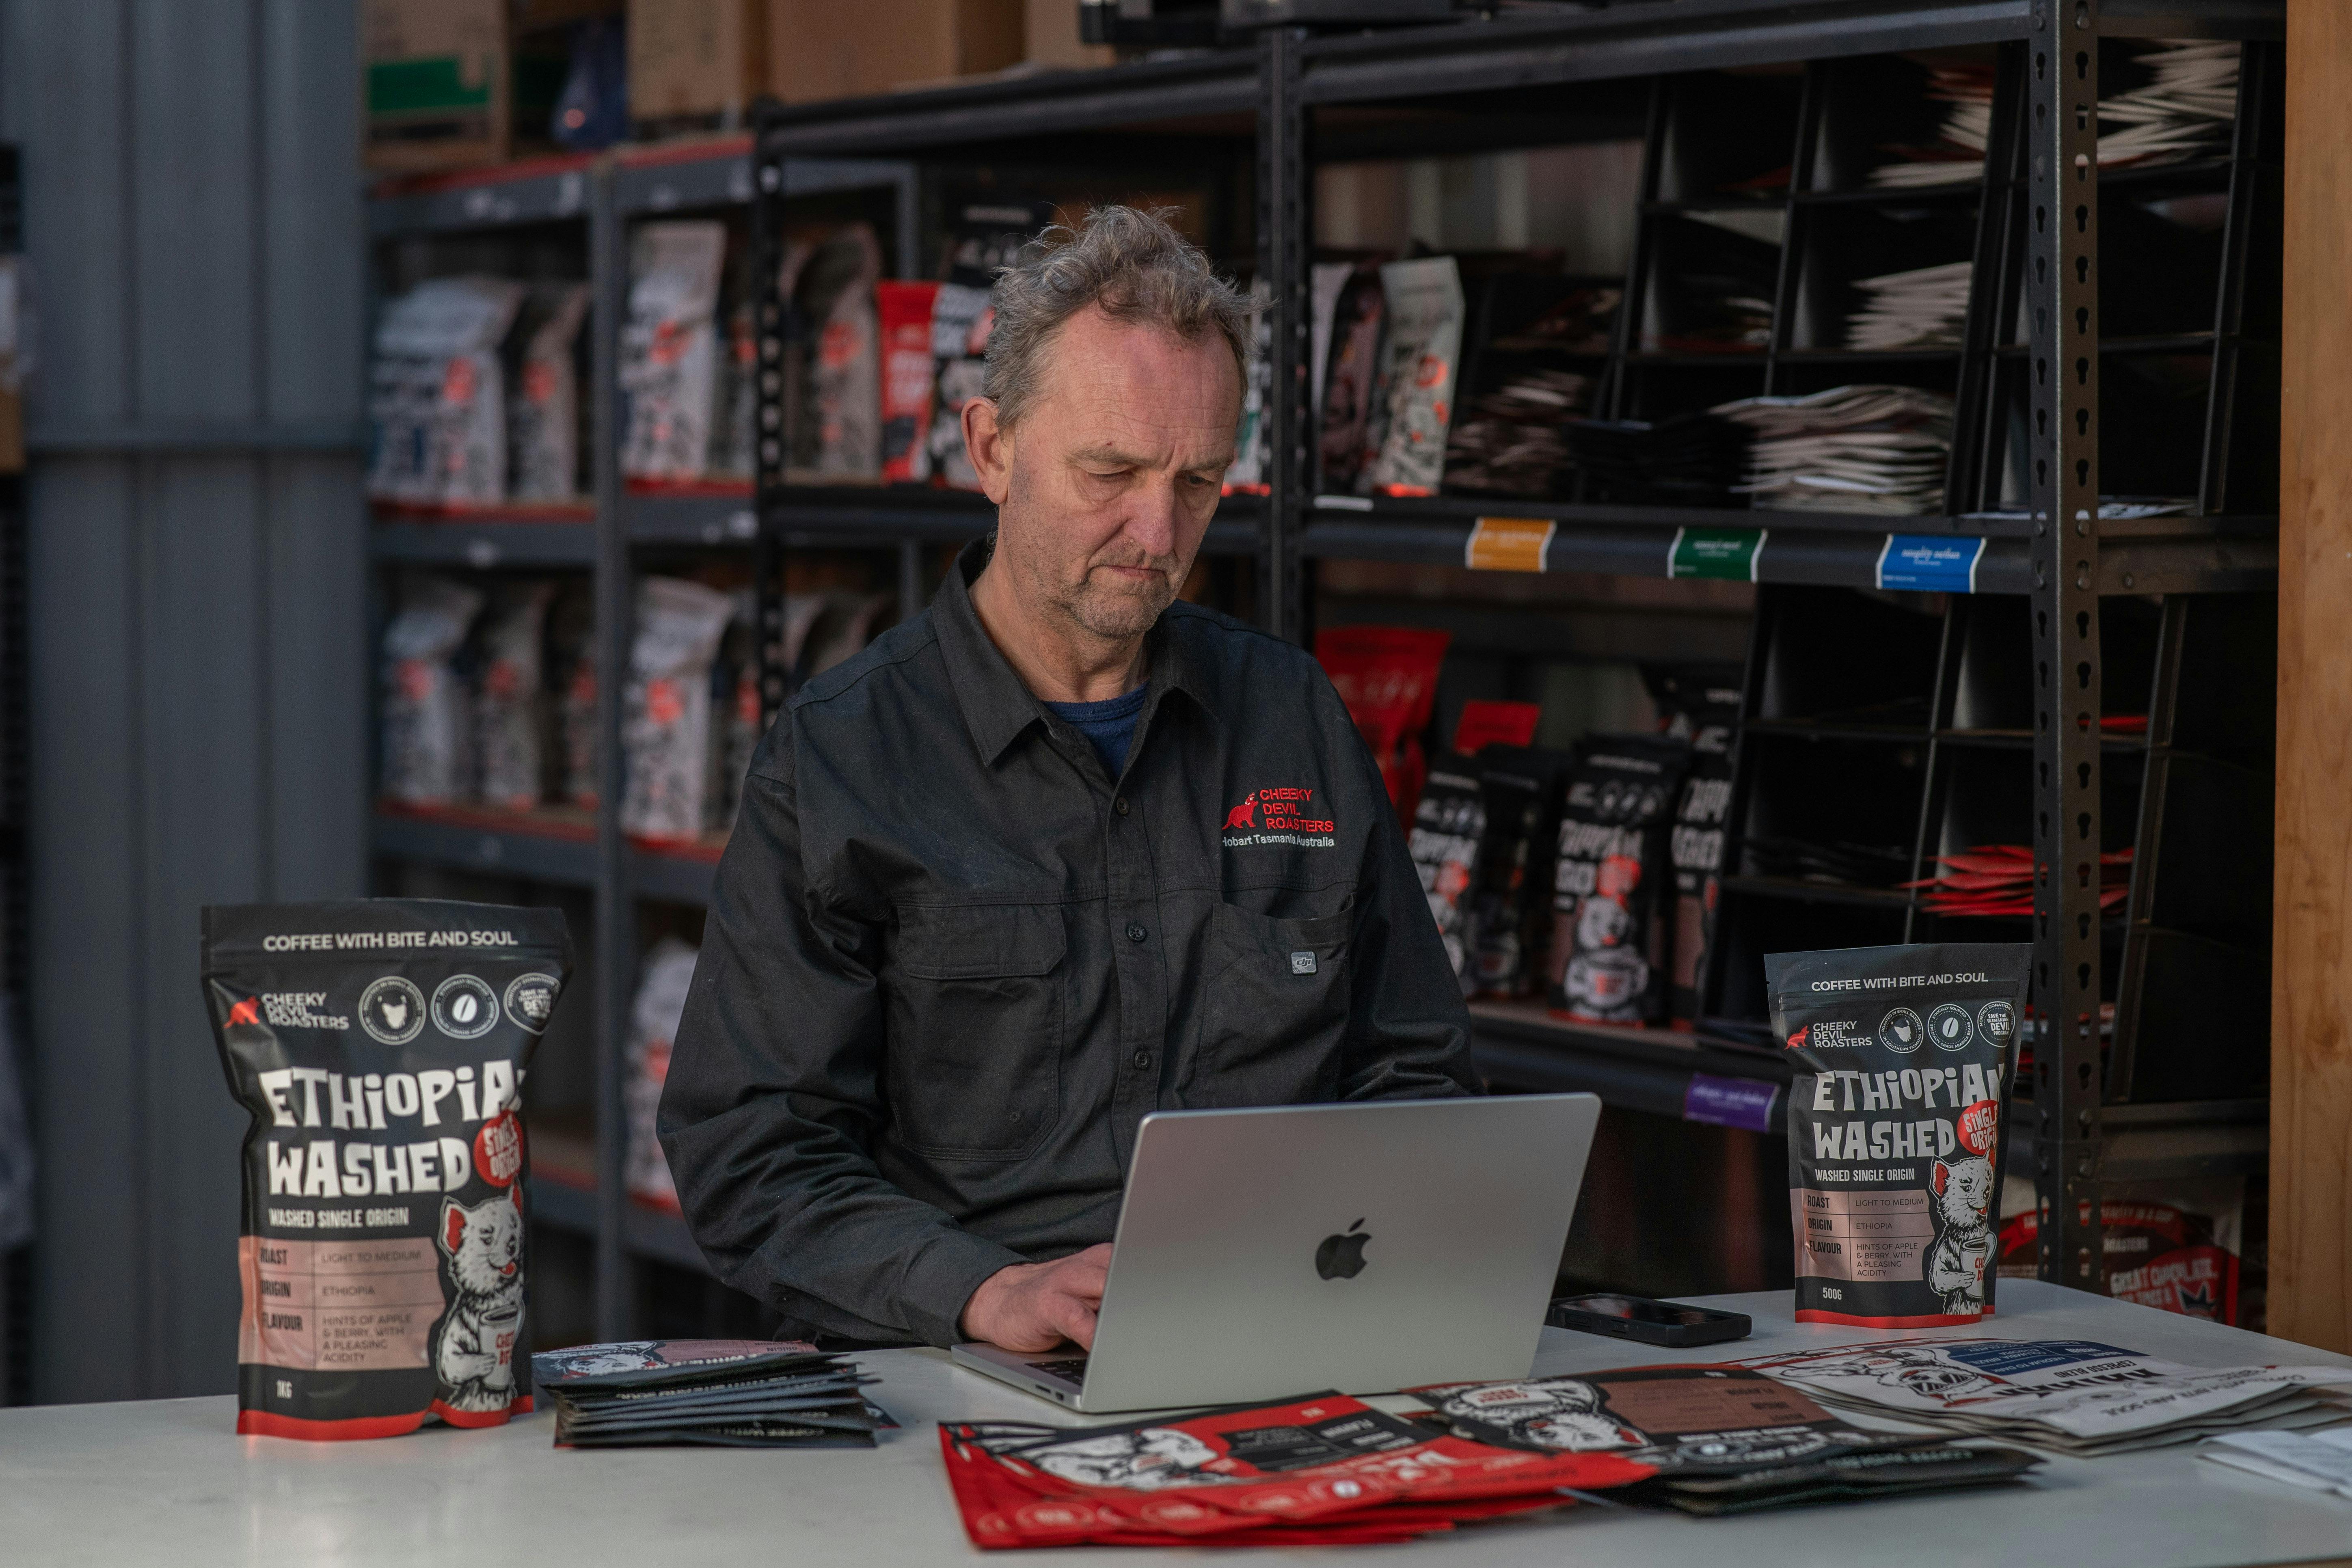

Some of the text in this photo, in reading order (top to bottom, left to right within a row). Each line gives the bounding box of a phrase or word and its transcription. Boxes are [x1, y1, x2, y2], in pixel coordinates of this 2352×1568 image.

[1260, 788, 1313, 801] CHEEKY
[1263, 803, 1300, 816] DEVIL
[1266, 817, 1334, 832] ROASTERS
[1253, 834, 1296, 844] Tasmania
[1296, 835, 1335, 847] Australia
[263, 931, 518, 952] COFFEE WITH BITE AND SOUL
[1811, 972, 1989, 991] COFFEE WITH BITE AND SOUL
[261, 992, 327, 1006] CHEEKY
[265, 1004, 312, 1016] DEVIL
[1932, 1006, 1967, 1019] ETHICALLY SOURCED
[269, 1014, 349, 1030] ROASTERS
[1881, 1014, 1892, 1032] ROASTED
[1909, 1013, 1921, 1030] BATCHES
[1979, 1007, 1988, 1027] MONTHLY
[1813, 1021, 1857, 1032] CHEEKY
[1990, 1022, 2010, 1031] DEVIL
[1813, 1030, 1846, 1040] DEVIL
[1930, 1024, 1941, 1043] SPECIALTY
[1955, 1036, 1969, 1048] ARABICA
[1814, 1037, 1873, 1048] ROASTERS
[1886, 1041, 1909, 1051] SOUTHERN
[1909, 1034, 1922, 1050] TASMANIA
[1812, 1118, 1955, 1160] WASHED
[268, 1138, 471, 1198] WASHED
[1815, 1168, 1915, 1182] WASHED SINGLE ORIGIN
[1807, 1195, 1830, 1209] ROAST
[269, 1207, 409, 1228] WASHED SINGLE ORIGIN
[1808, 1218, 1832, 1231] ORIGIN
[1809, 1240, 1841, 1255] FLAVOUR
[260, 1247, 287, 1264] ROAST
[322, 1250, 421, 1263] LIGHT TO MEDIUM
[261, 1279, 291, 1297] ORIGIN
[322, 1286, 375, 1296] ETHIOPIA
[1823, 1287, 1842, 1300] 500G
[322, 1313, 413, 1325] HINTS OF APPLE
[374, 1326, 405, 1336] WITH
[322, 1339, 388, 1350] A PLEASING
[324, 1352, 366, 1363] ACIDITY
[1998, 1348, 2041, 1356] ETHIOPIA
[2030, 1356, 2066, 1367] MEDIUM
[2053, 1359, 2138, 1378] ESPRESSO BLEND
